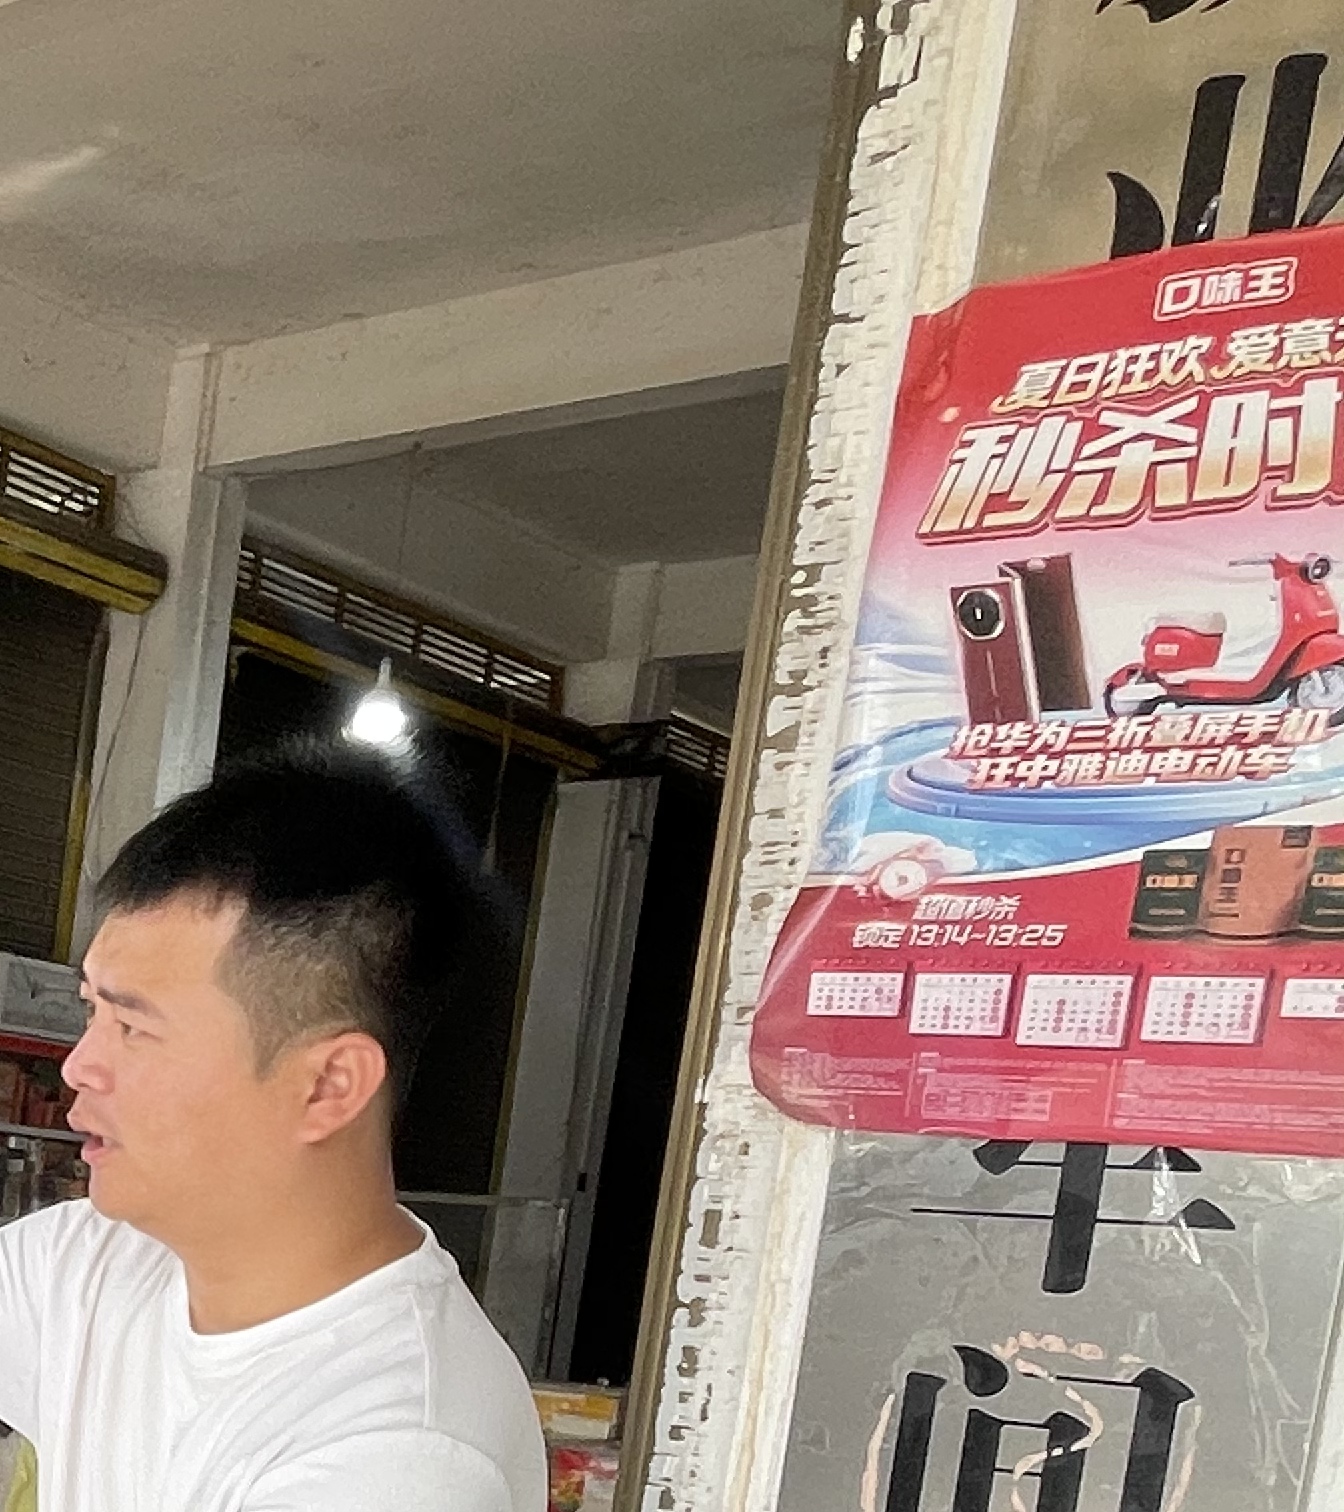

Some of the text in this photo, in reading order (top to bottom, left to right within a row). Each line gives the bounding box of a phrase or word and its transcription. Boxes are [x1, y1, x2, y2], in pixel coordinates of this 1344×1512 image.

[1161, 264, 1290, 314] 口味王
[993, 336, 1213, 414] 夏日狂欢
[916, 377, 1344, 535] 秒杀时
[953, 708, 1331, 757] 抢华为三折叠屏手机
[969, 746, 1293, 788] 狂中雅迪电动车
